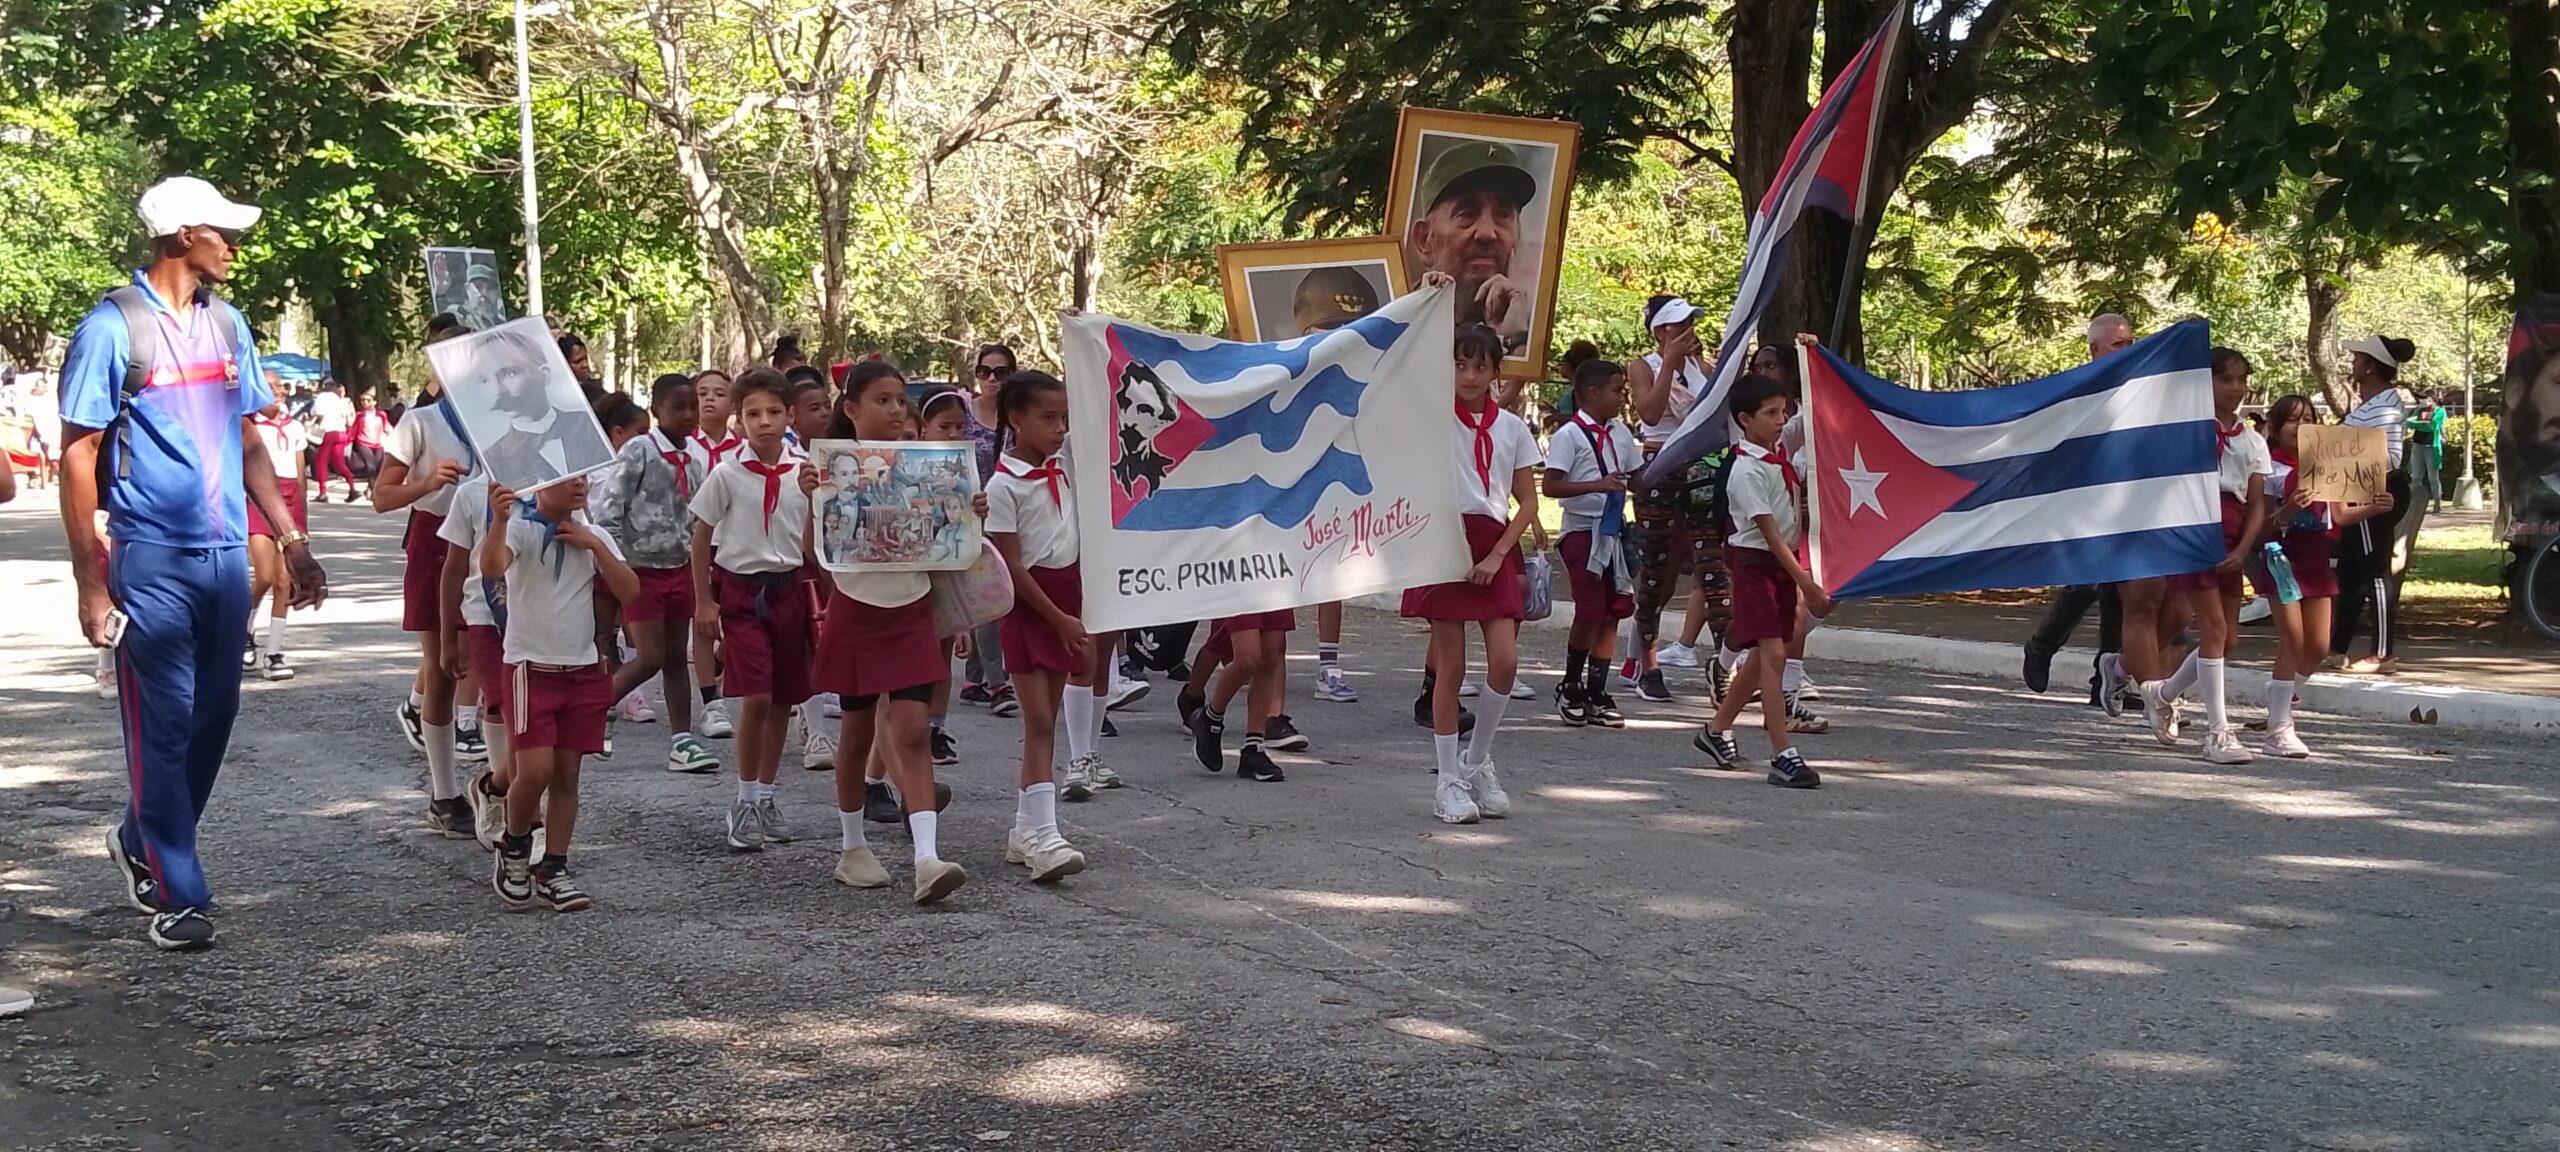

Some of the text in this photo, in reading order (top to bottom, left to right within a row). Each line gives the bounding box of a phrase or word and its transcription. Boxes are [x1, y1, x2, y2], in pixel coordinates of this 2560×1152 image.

[2304, 428, 2366, 460] Viva el
[1302, 506, 1343, 551] José
[1118, 552, 1294, 596] ESC. PRIMARIA
